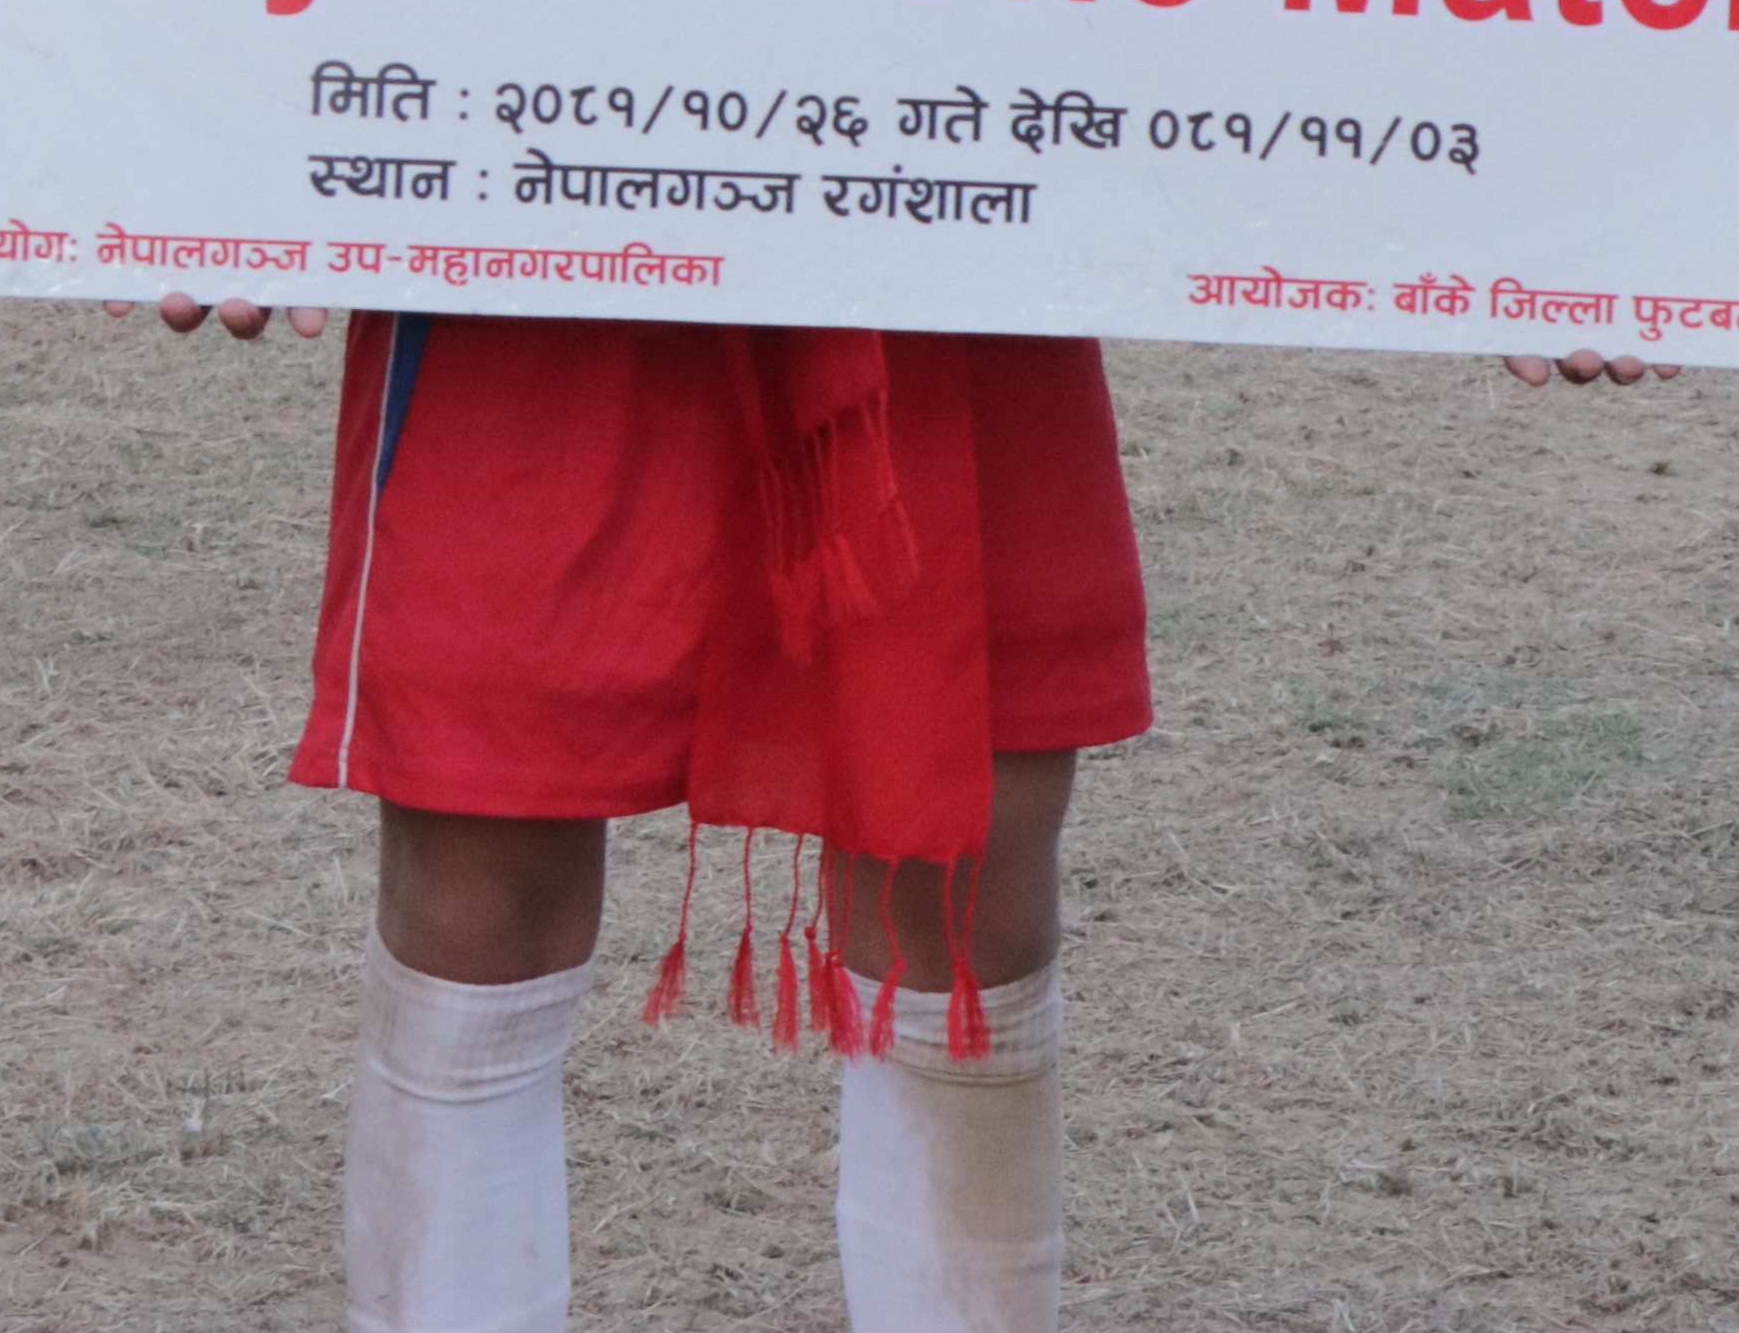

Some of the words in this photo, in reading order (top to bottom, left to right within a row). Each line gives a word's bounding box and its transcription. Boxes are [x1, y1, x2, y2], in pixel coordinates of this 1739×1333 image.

[310, 60, 437, 122] मिति
[495, 82, 869, 143] २०८१/१०/२६
[896, 84, 990, 144] गते
[1009, 87, 1128, 155] देखि
[1148, 109, 1480, 176] ०८१/११/०३
[308, 155, 457, 201] स्थान
[513, 147, 802, 214] नेपालगञ्ज
[97, 222, 312, 271] नेपालगञ्ज
[327, 241, 725, 286] उप-महानगरपालिका
[1189, 265, 1376, 311] आयोजक:
[1394, 273, 1476, 316] बाँके
[1489, 277, 1619, 325] जिल्ला
